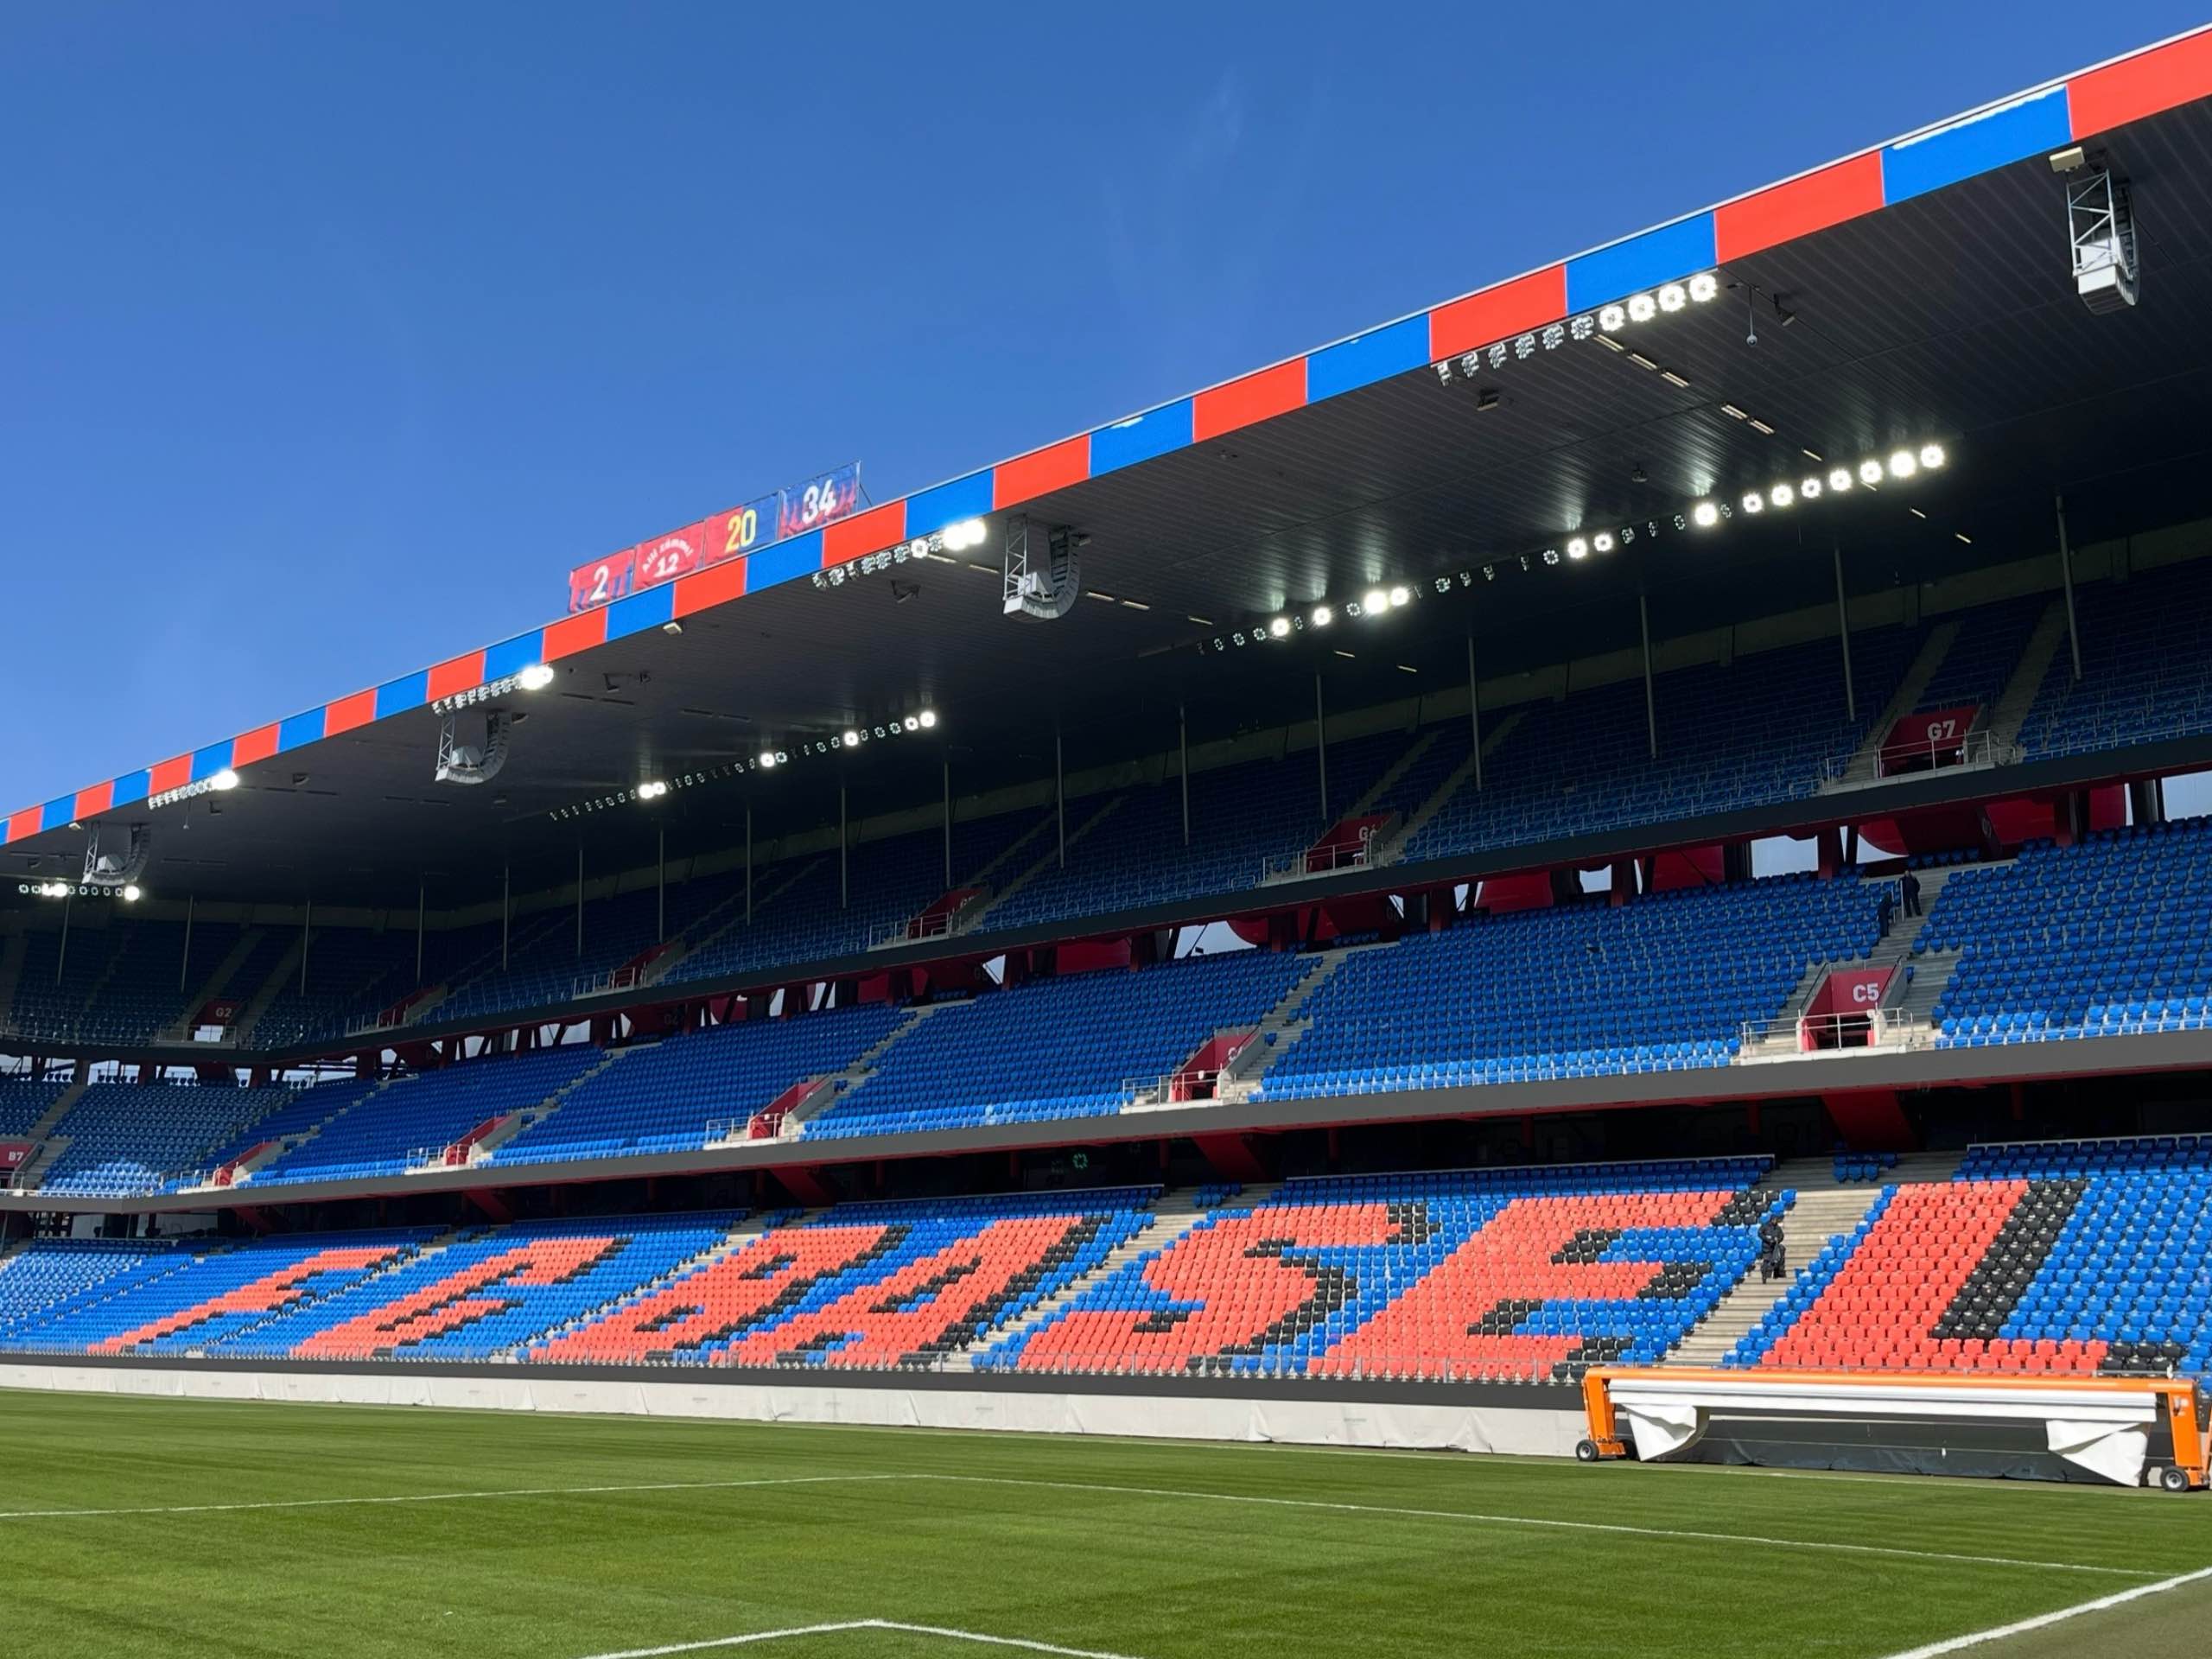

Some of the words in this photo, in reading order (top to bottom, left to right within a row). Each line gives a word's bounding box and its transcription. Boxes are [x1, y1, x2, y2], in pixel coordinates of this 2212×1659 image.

[802, 479, 836, 524] 34
[724, 509, 757, 553] 20
[654, 552, 678, 577] 12
[589, 564, 609, 601] 2
[1928, 719, 1956, 741] G7
[1853, 982, 1879, 1003] C5
[216, 1007, 232, 1017] G2
[9, 1151, 24, 1161] B7
[529, 1179, 2143, 1377] BASEL
